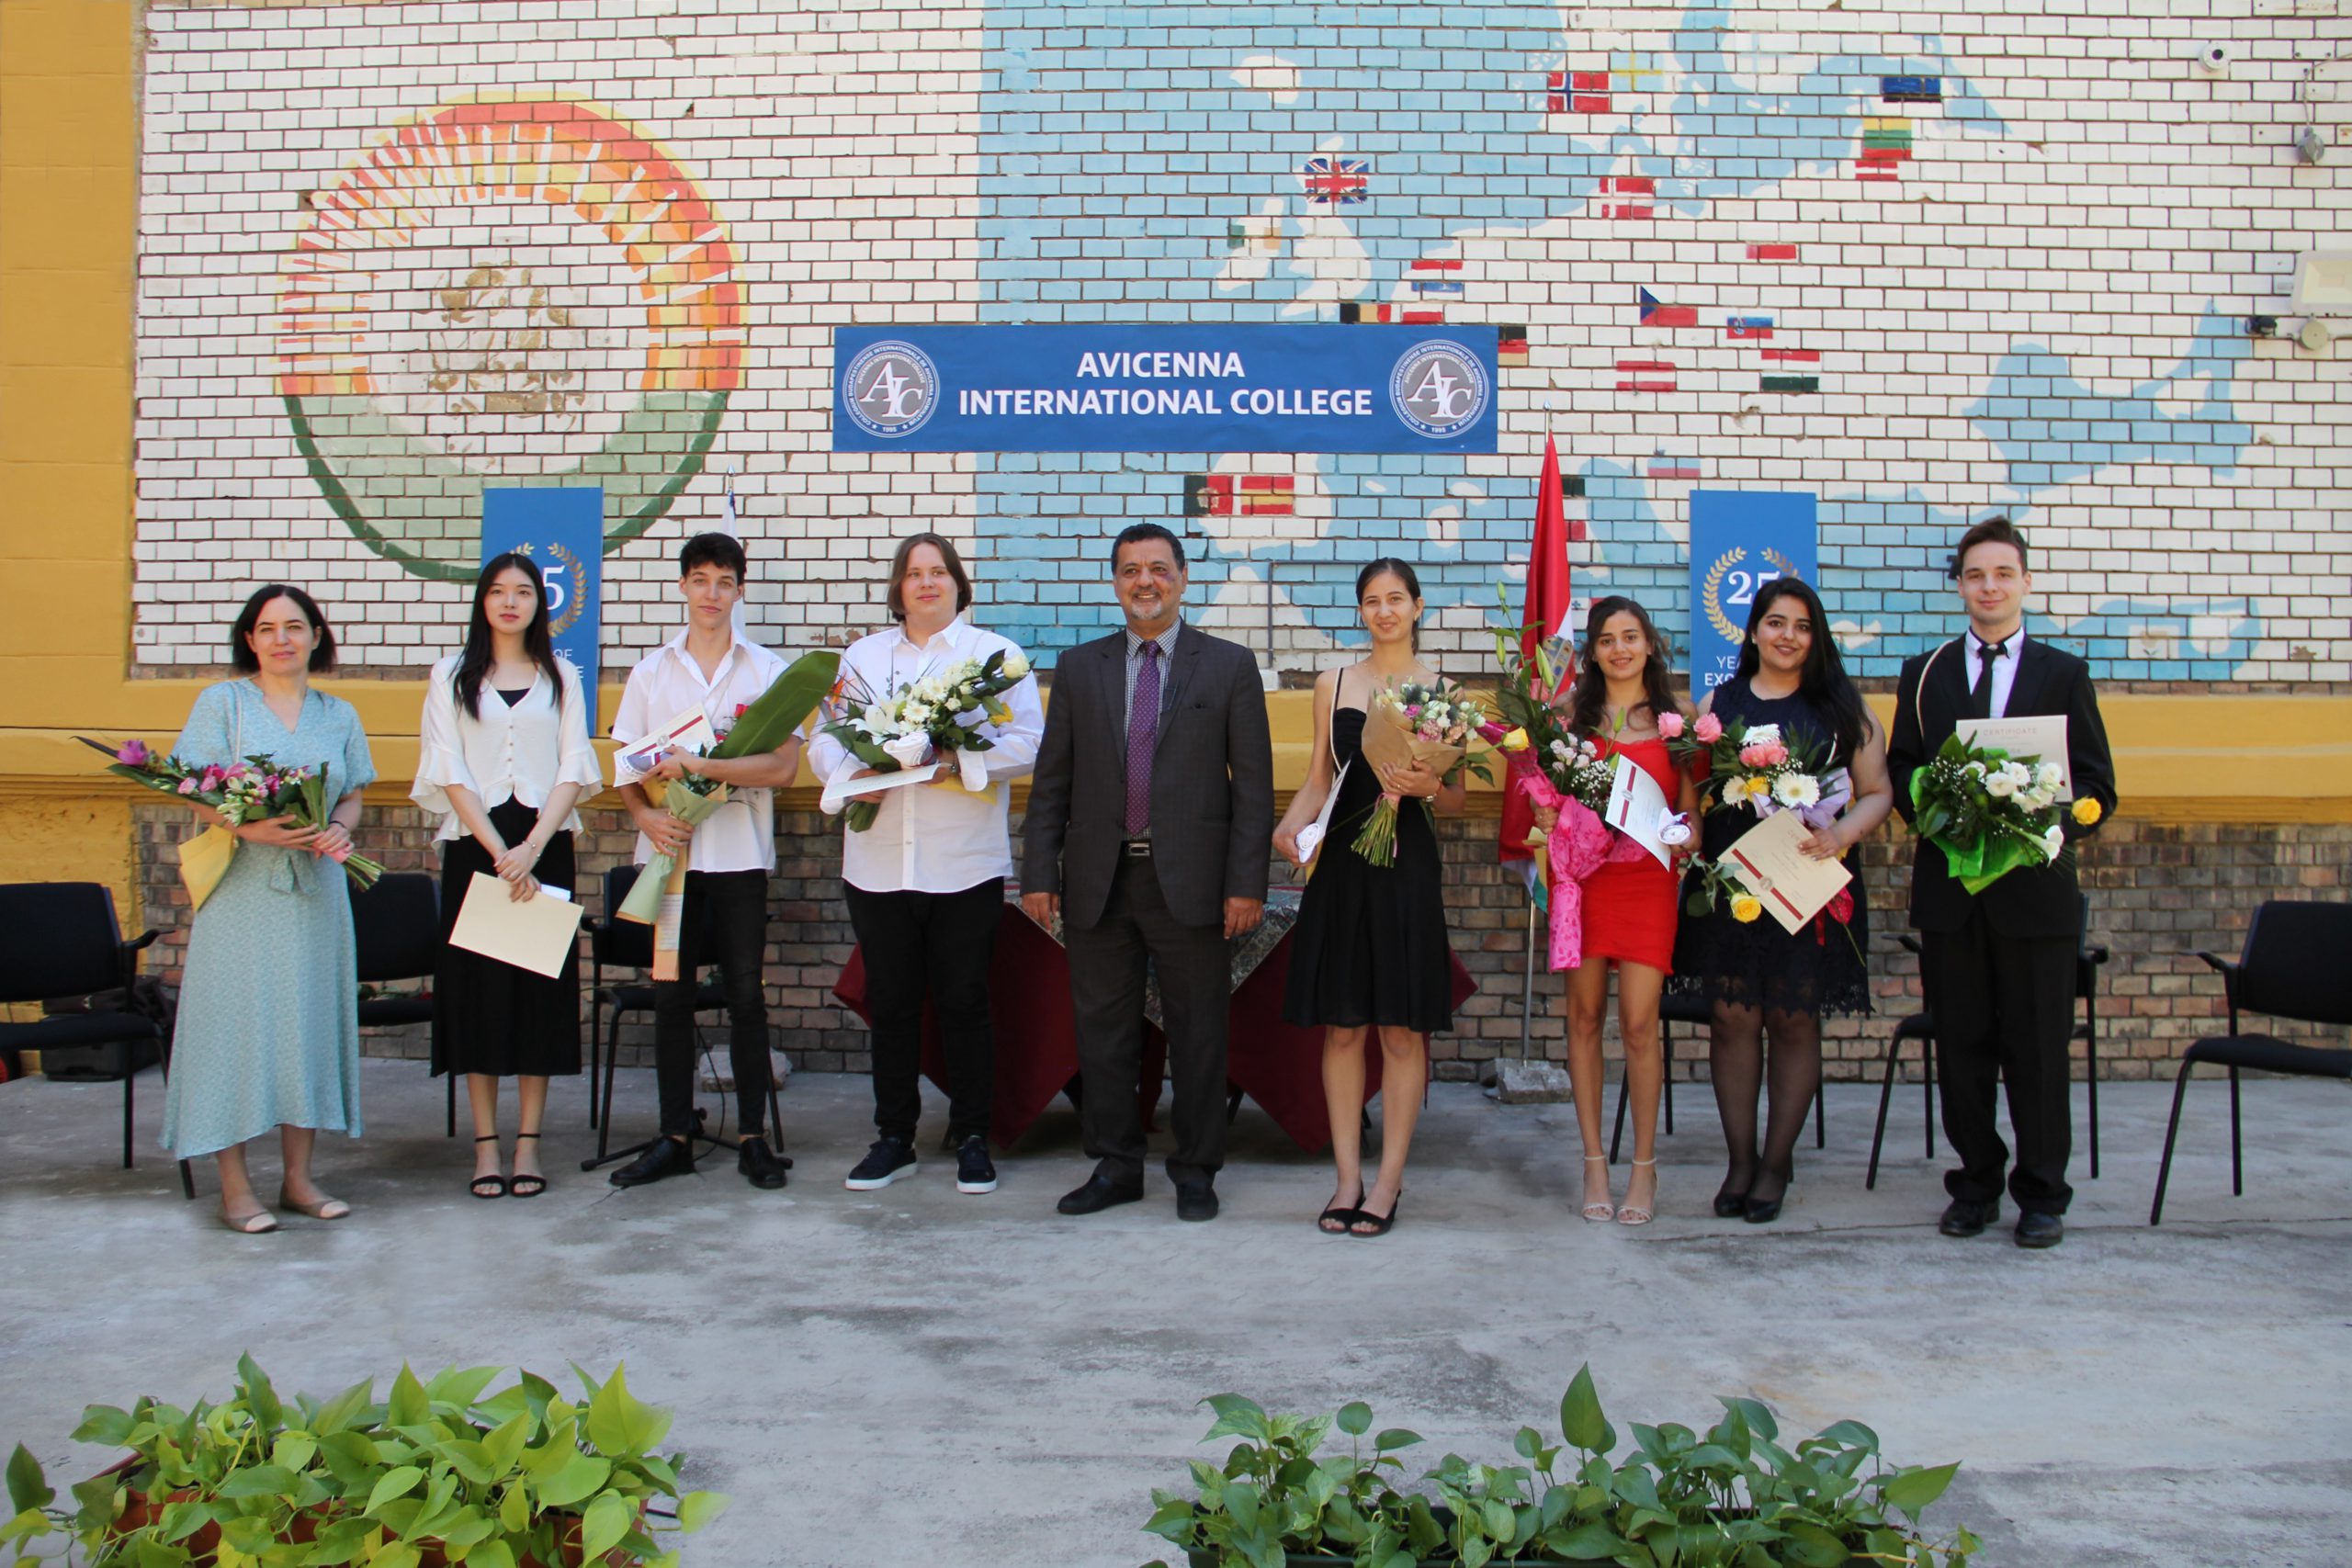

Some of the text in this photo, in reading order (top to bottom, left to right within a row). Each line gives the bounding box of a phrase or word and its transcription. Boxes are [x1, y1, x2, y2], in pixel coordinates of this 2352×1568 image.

[873, 345, 922, 361] INTERNATIONALE
[1420, 344, 1469, 360] INTERNATIONALE
[1076, 352, 1246, 378] AVICENNA
[959, 389, 1373, 415] INTERNATIONAL COLLEGE
[542, 565, 566, 610] 5
[1984, 727, 2037, 736] CERTIFICATE
